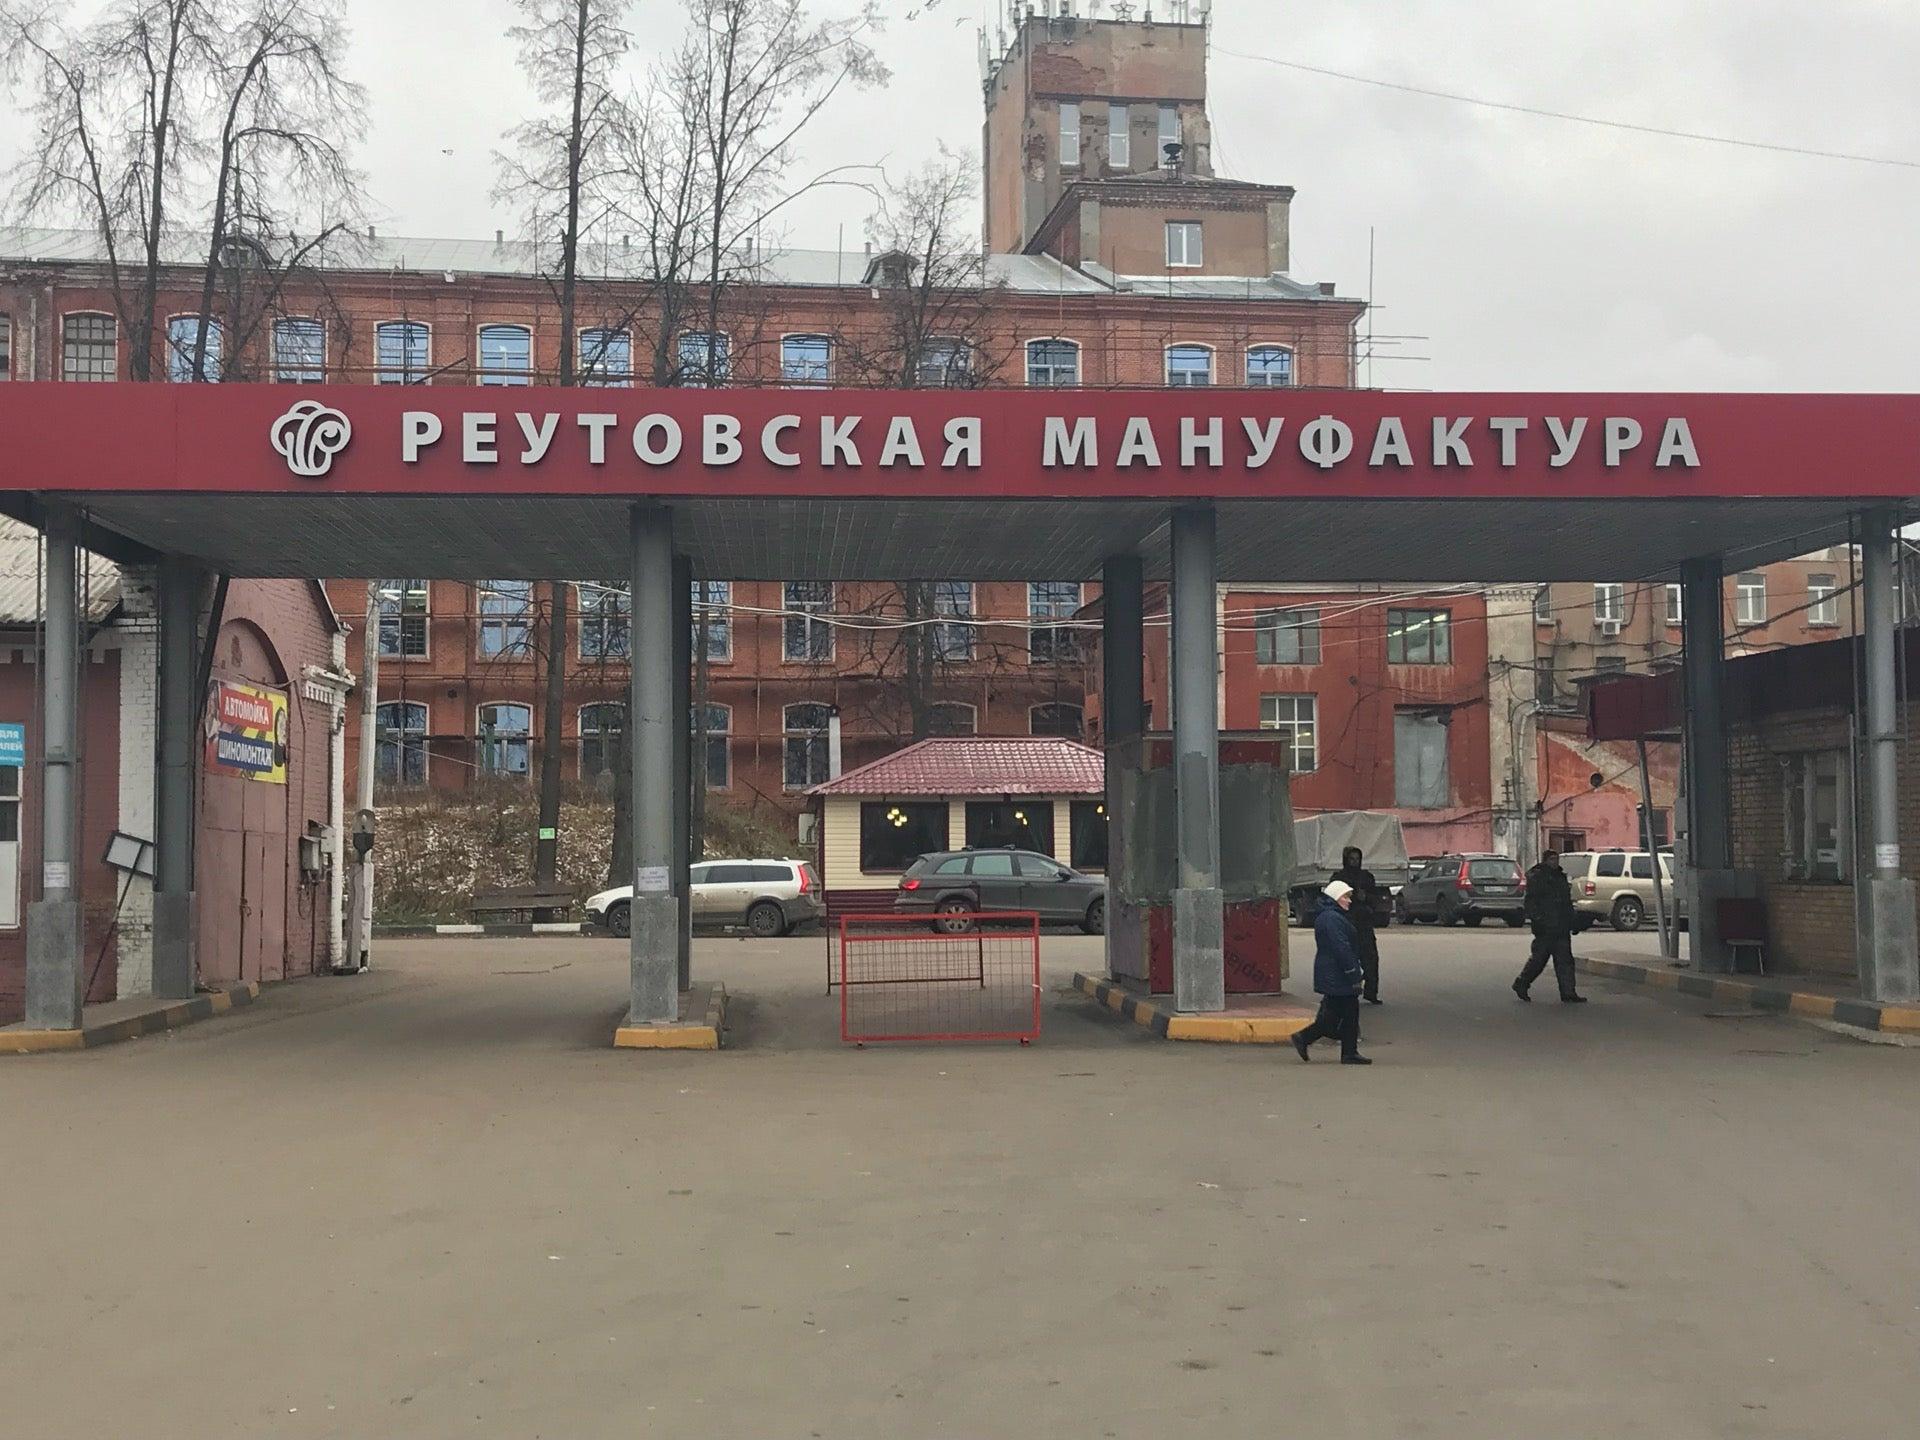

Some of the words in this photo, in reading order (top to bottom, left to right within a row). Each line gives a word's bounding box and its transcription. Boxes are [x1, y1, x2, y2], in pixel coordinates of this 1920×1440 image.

[402, 411, 982, 467] РЕУТОВСКАЯ
[1042, 415, 1701, 469] МАНУФАКТУРА
[224, 695, 270, 726] АВТОМОЙКА
[218, 738, 273, 767] ШИНОМОНТАЖ
